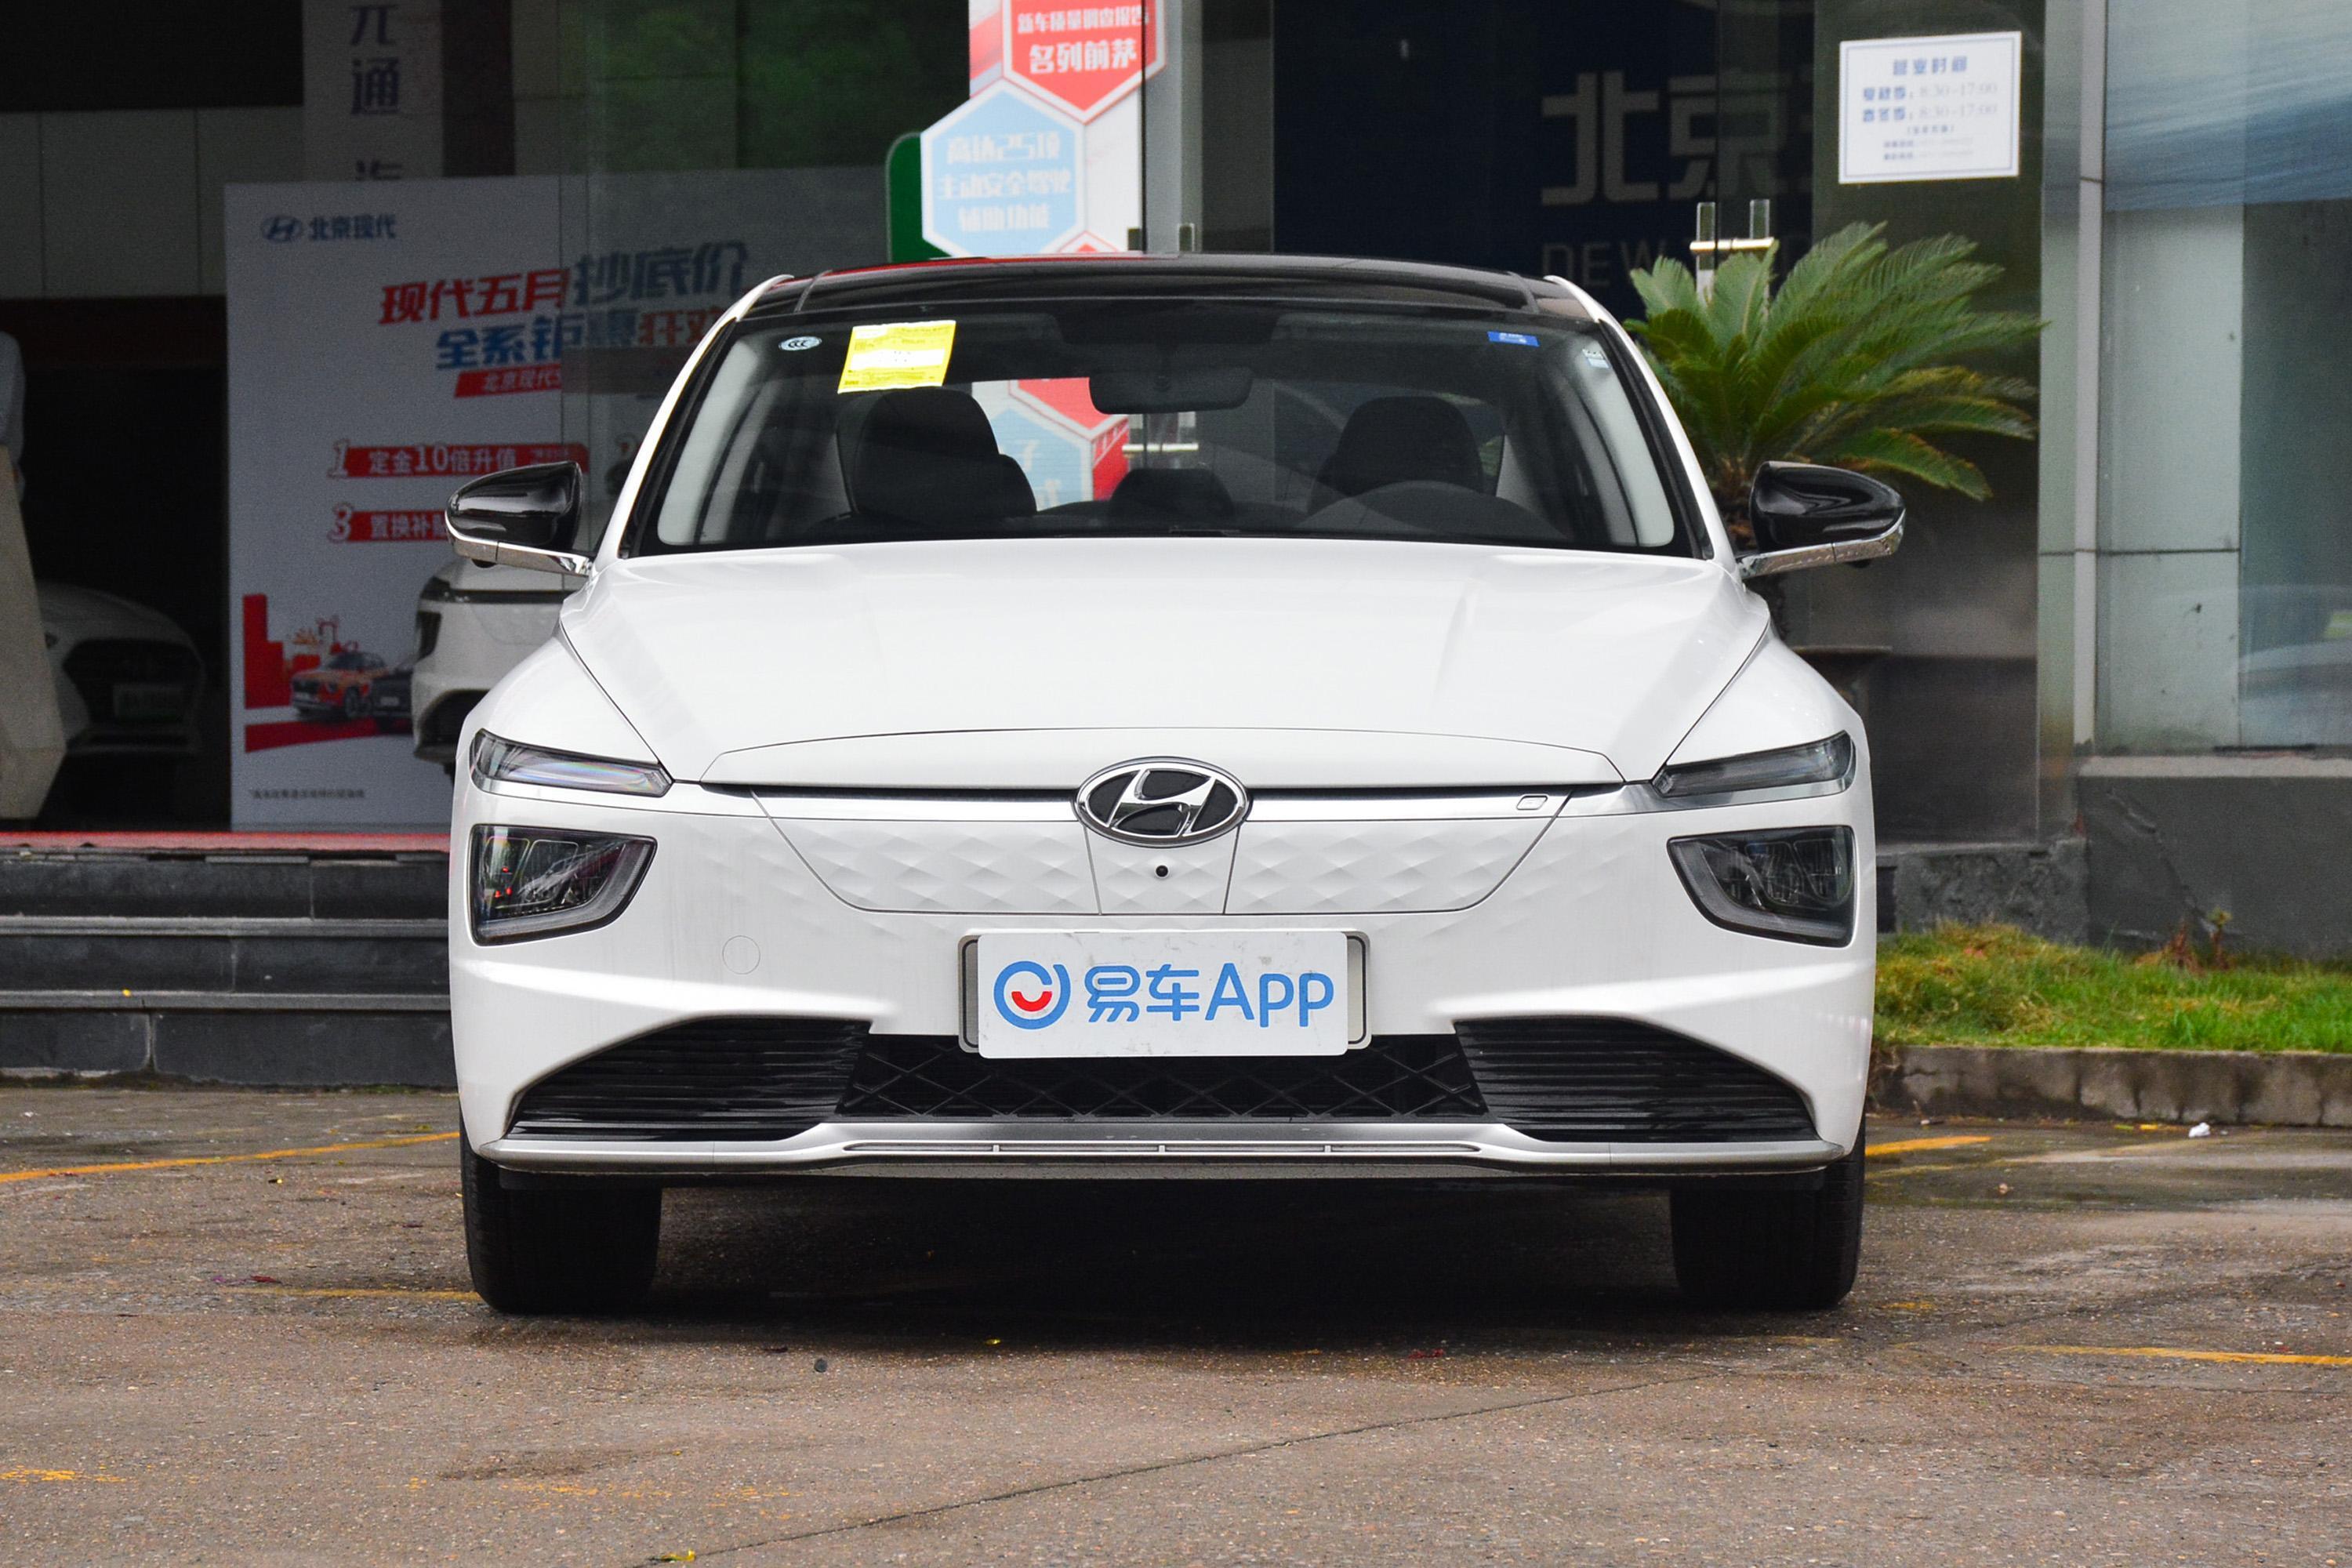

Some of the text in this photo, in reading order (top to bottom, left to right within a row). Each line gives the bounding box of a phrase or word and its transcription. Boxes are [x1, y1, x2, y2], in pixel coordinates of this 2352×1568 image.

[1029, 38, 1137, 74] 名列前茅
[1541, 71, 1813, 205] 北京
[308, 213, 397, 241] 北京现代
[1084, 962, 1334, 1028] 易车App
